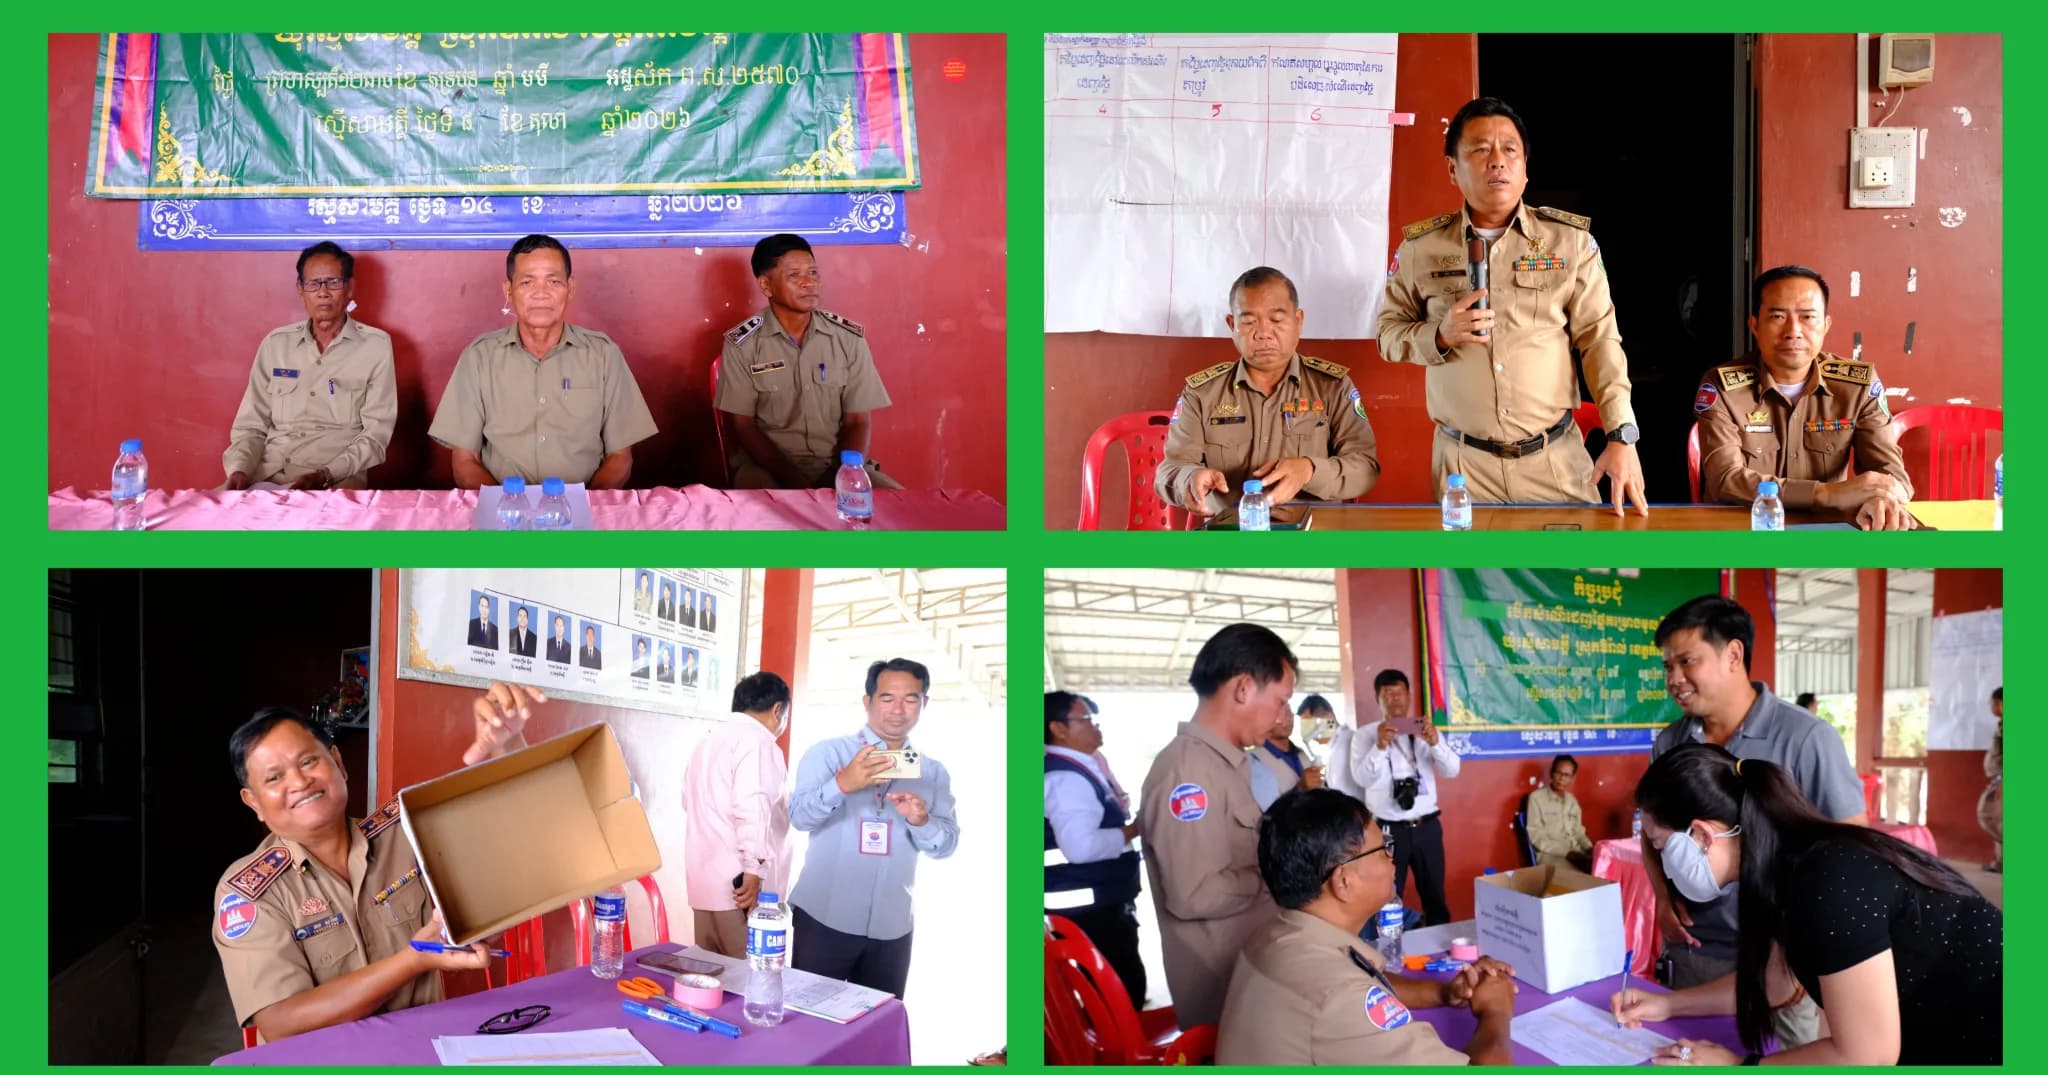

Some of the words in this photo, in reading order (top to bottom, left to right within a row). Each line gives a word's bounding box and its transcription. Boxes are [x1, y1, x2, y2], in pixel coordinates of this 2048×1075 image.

[493, 63, 515, 95] ឆ្នាំ
[502, 105, 523, 133] ខែ
[1211, 103, 1222, 118] 5
[1310, 107, 1322, 121] 6
